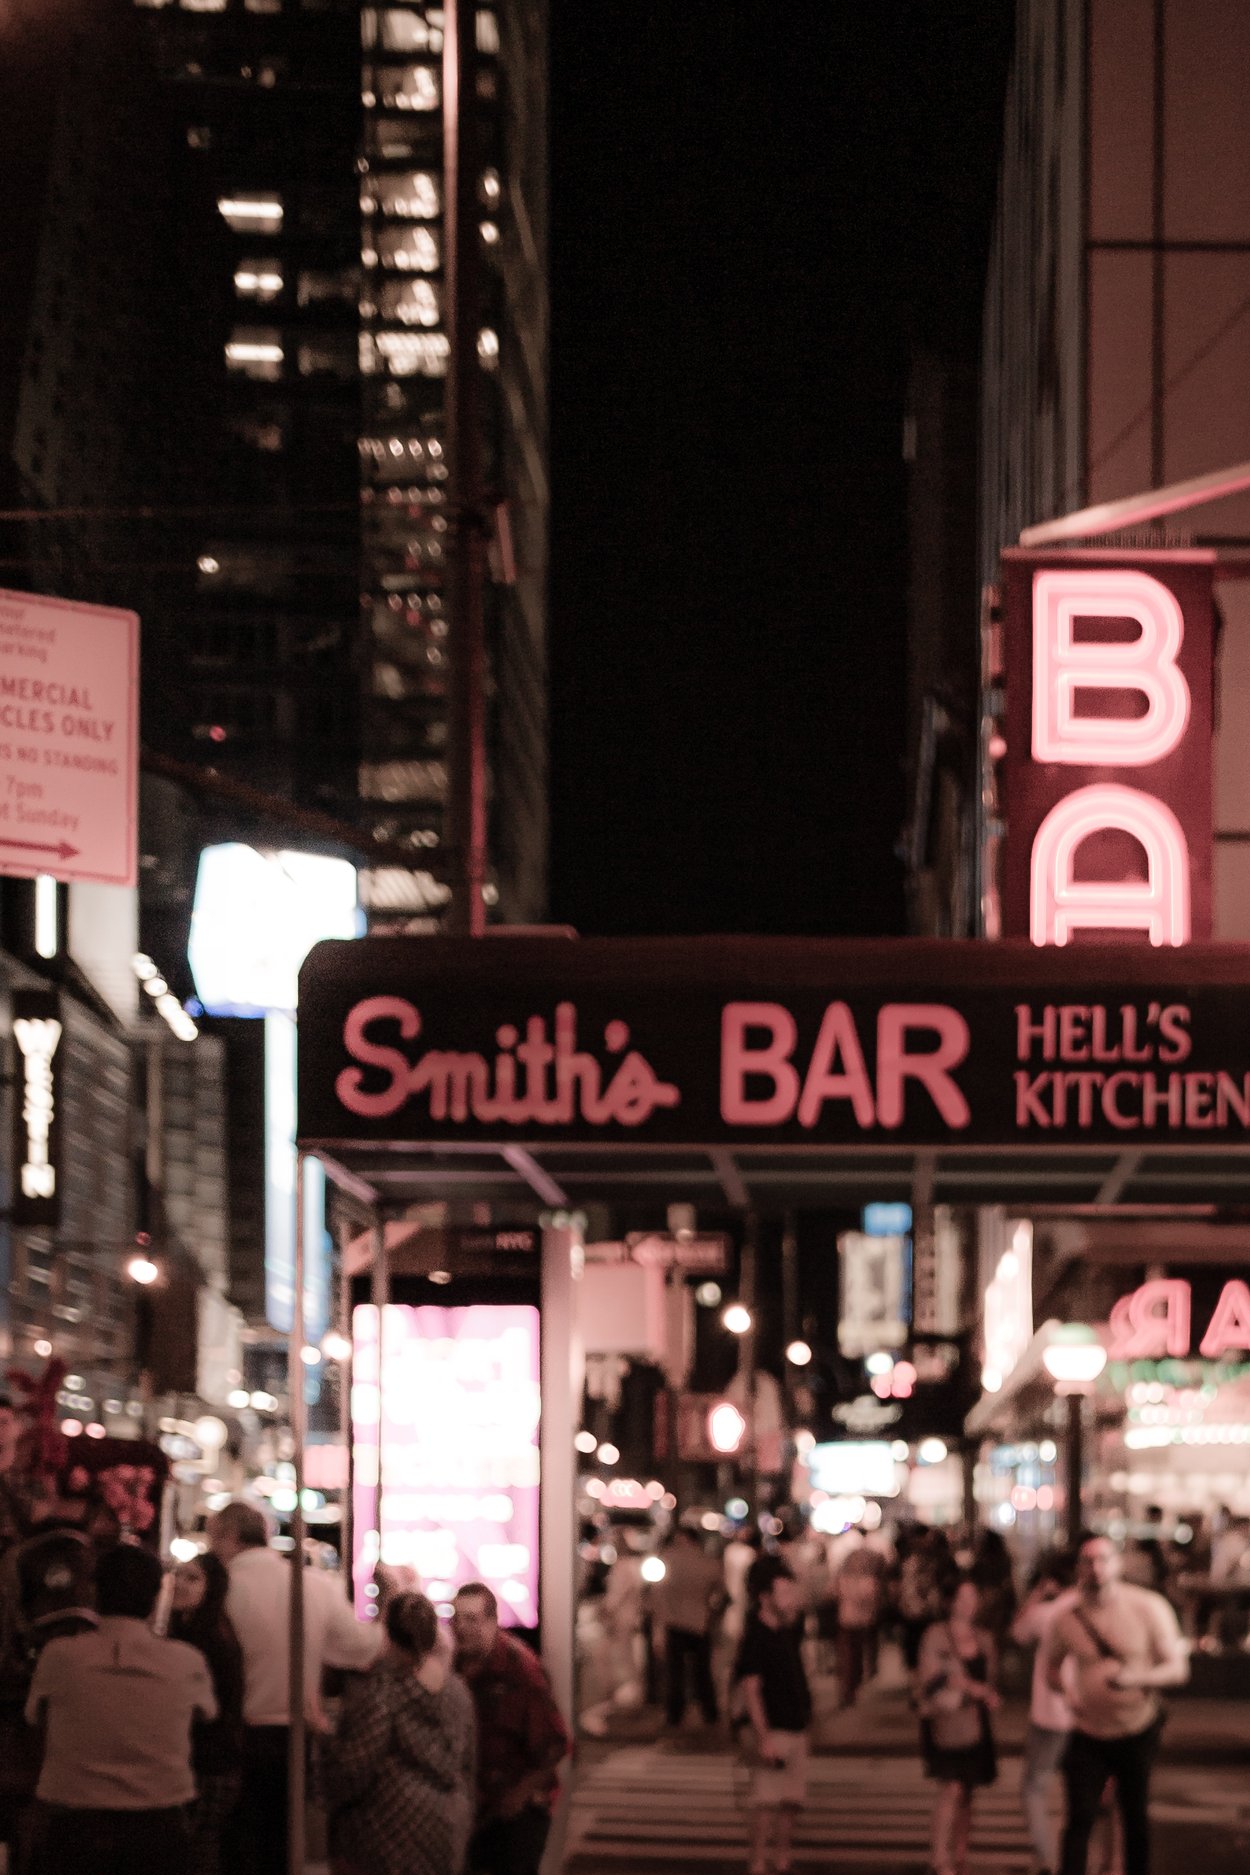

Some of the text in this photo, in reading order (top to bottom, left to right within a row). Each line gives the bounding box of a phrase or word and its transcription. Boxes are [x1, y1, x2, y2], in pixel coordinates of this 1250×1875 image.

[61, 713, 115, 742] ONLY
[43, 748, 119, 775] STANDING
[1014, 1002, 1192, 1063] HELL'S
[335, 996, 971, 1128] Smith's BAR
